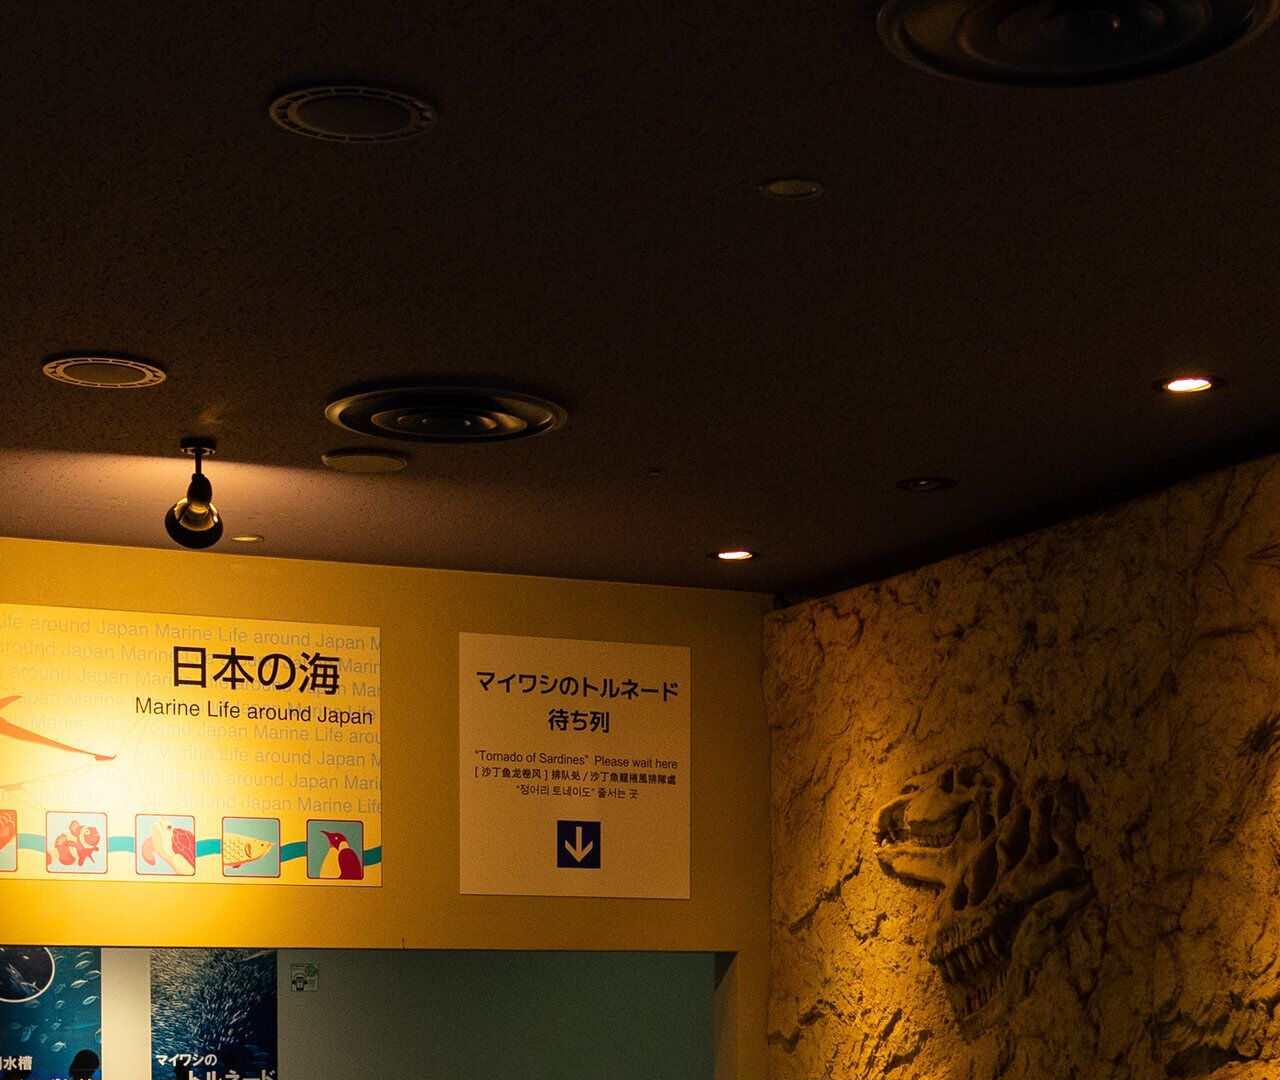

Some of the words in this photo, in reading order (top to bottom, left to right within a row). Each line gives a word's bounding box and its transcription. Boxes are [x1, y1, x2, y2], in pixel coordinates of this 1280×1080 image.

[30, 618, 91, 634] around
[96, 620, 149, 639] Japan
[154, 623, 213, 641] Marine
[218, 626, 248, 643] Life
[254, 629, 310, 646] around
[316, 633, 365, 650] Japan
[62, 643, 115, 662] Japan
[10, 666, 71, 682] around
[76, 668, 129, 687] Japan
[173, 646, 340, 695] 日本の海
[476, 671, 678, 701] マイワシのトルネード
[135, 697, 200, 716] Marine
[207, 701, 241, 719] Life
[247, 704, 311, 721] around
[317, 706, 373, 727] Japan
[548, 708, 609, 733] 待ち列
[197, 722, 248, 740] Japan
[253, 725, 309, 741] Marine
[315, 728, 344, 742] Life
[219, 747, 249, 762] Life
[254, 749, 311, 765] around
[316, 751, 366, 768] Japan
[526, 753, 537, 763] of
[594, 755, 629, 767] Please
[632, 757, 653, 768] wait
[655, 758, 678, 769] here
[227, 772, 284, 788] around
[289, 774, 338, 791] Japan
[242, 796, 290, 812] Japan
[297, 797, 352, 813] Marine
[155, 1053, 218, 1067] マイワシの
